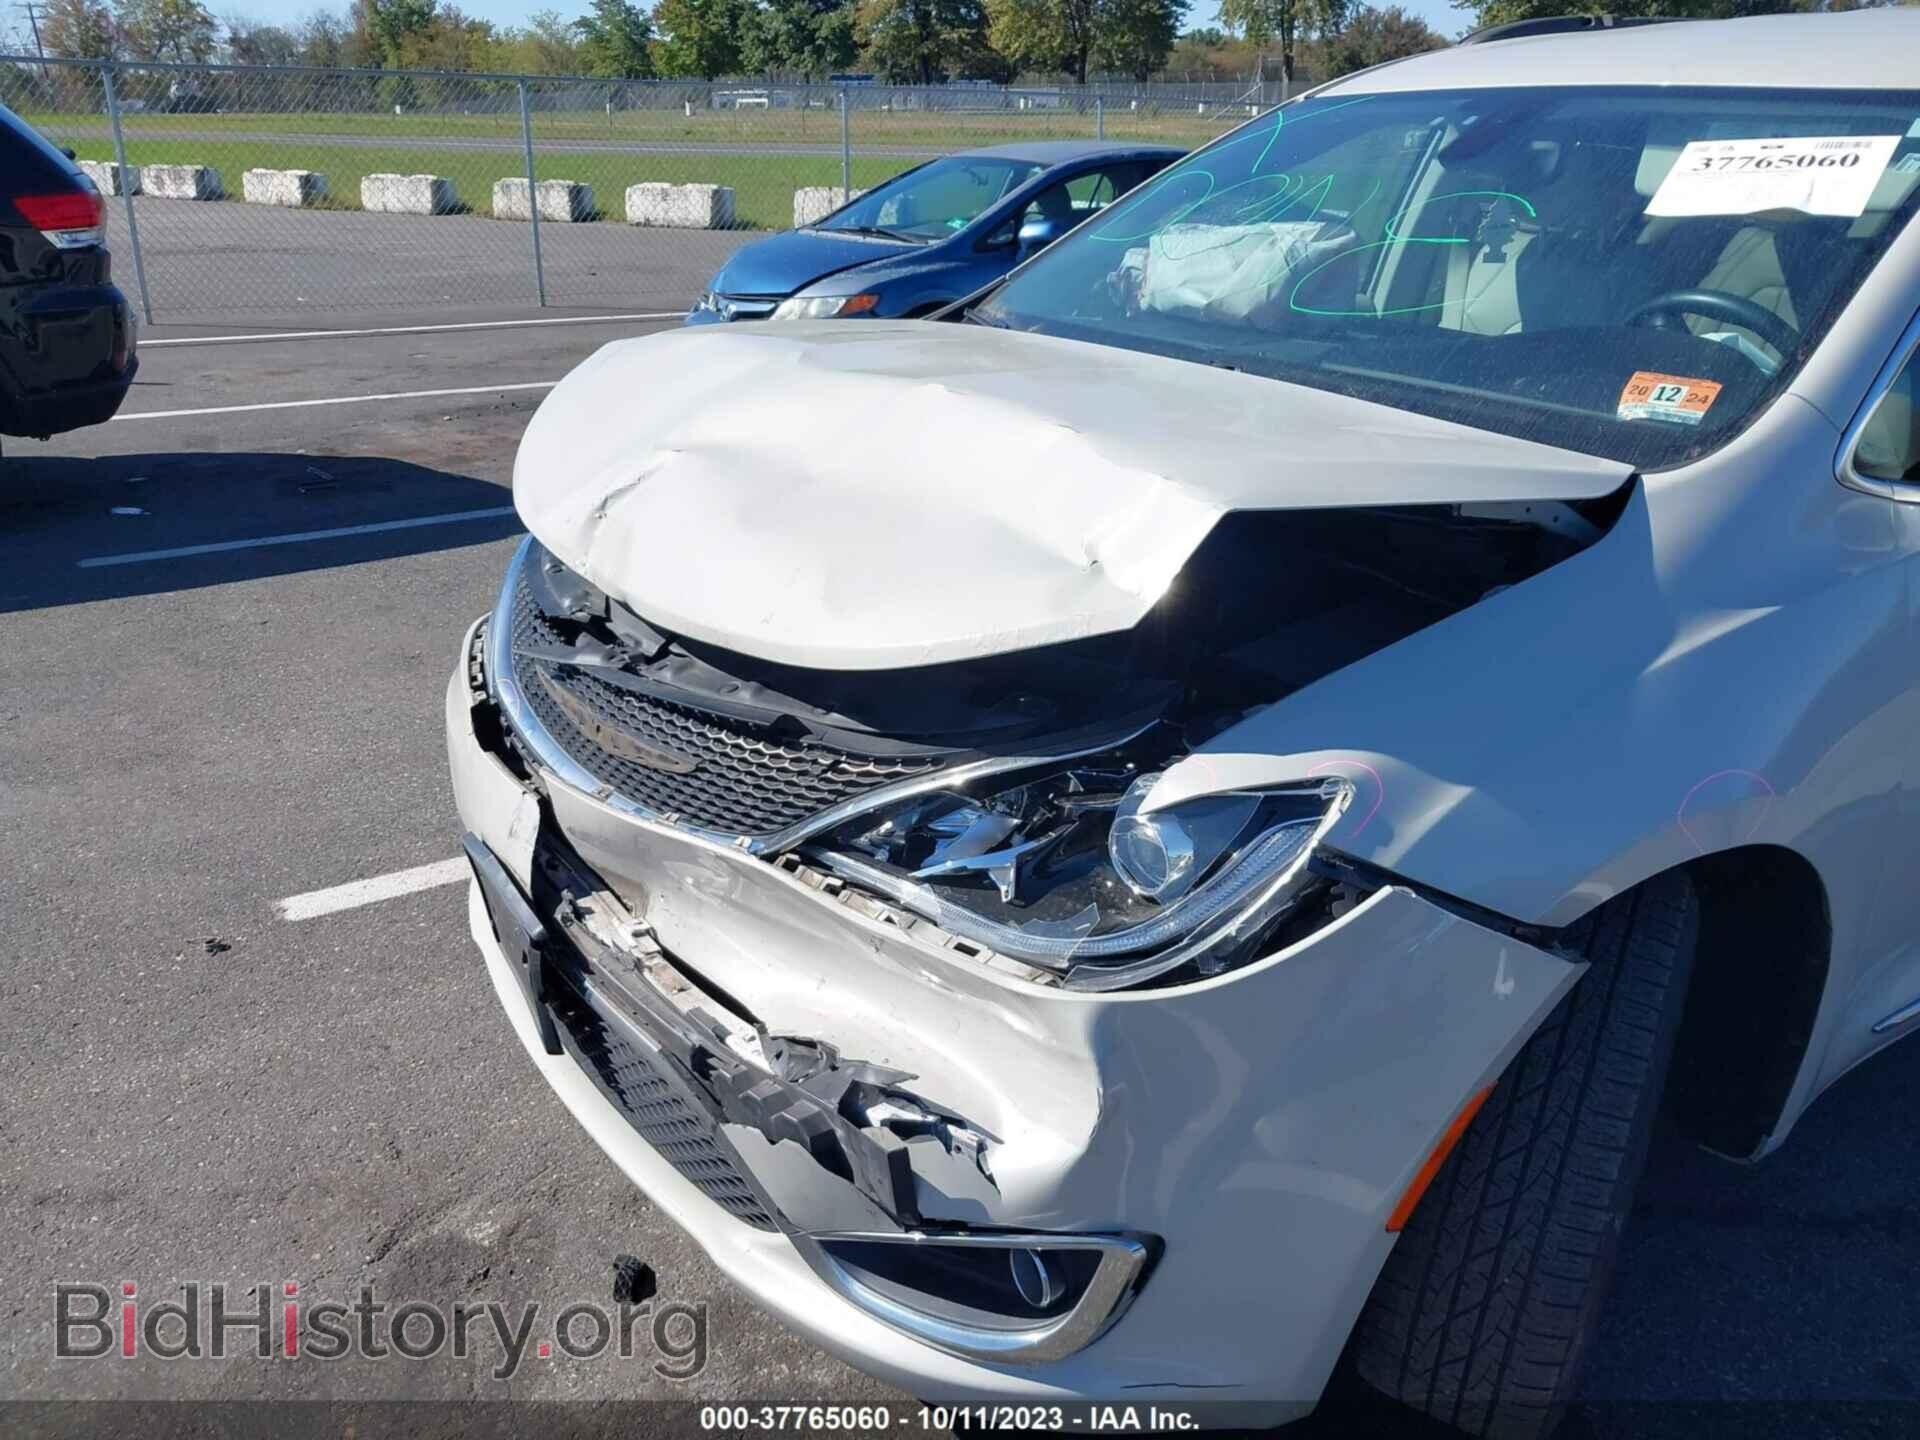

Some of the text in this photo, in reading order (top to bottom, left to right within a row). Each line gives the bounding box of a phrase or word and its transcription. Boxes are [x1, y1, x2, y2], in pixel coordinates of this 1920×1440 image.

[1692, 152, 1861, 172] 37765060
[1628, 384, 1709, 405] 20 12 24
